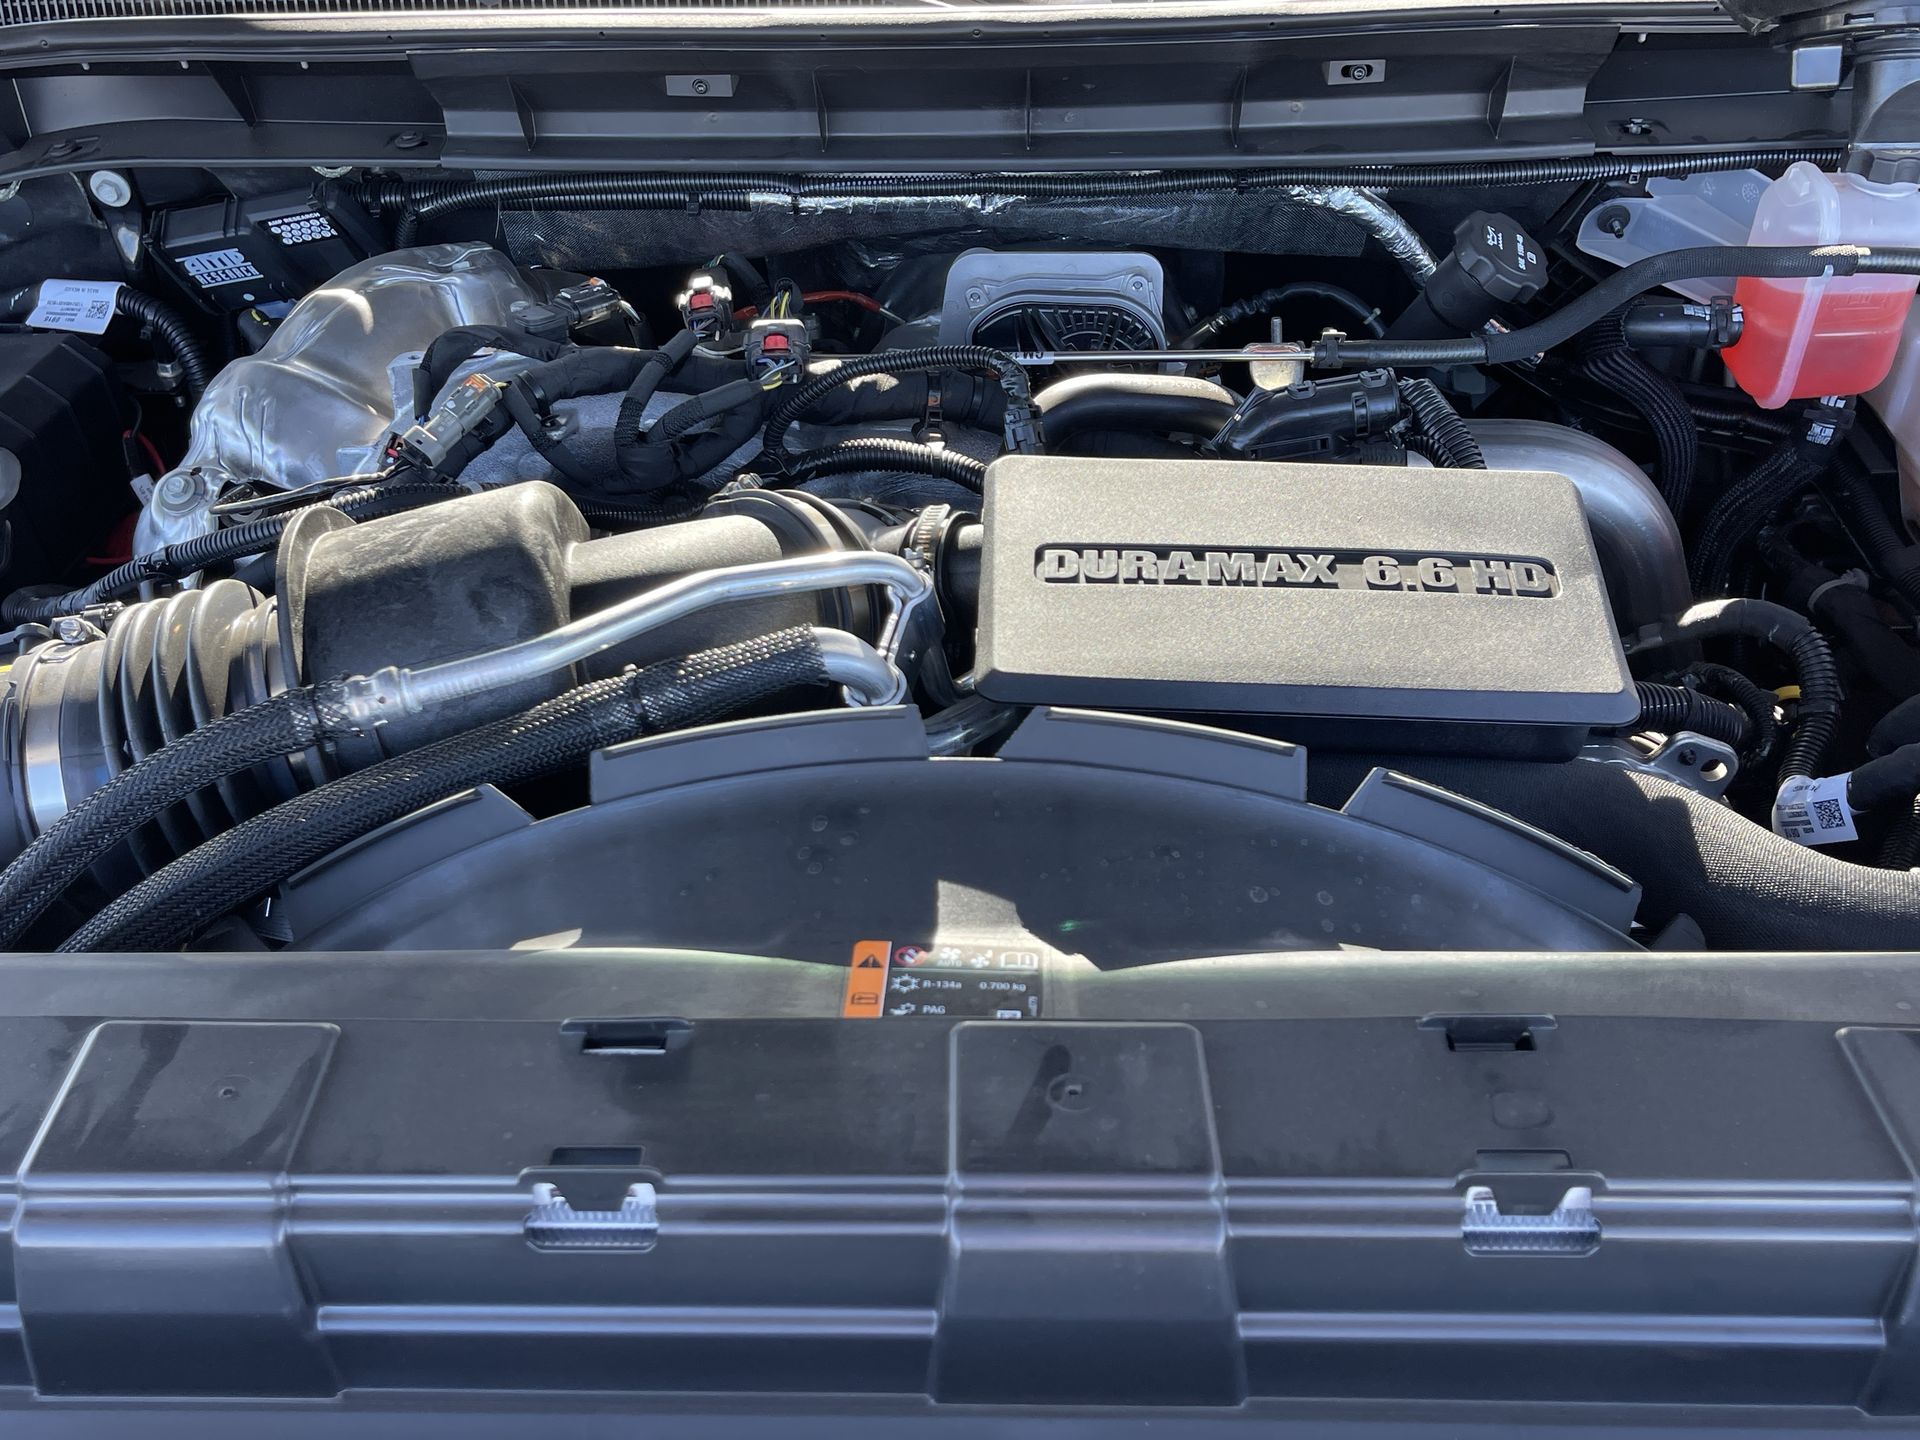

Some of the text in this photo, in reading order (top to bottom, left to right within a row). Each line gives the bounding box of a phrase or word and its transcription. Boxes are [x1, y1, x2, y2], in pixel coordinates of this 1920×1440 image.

[283, 212, 321, 224] RESEARCH
[183, 250, 245, 275] AMP
[195, 265, 260, 285] RESEARCH
[1042, 548, 1556, 595] DURAMAX 6.6 HD
[936, 958, 963, 968] AUTO
[922, 979, 1027, 992] R-134a 0.700 kg
[922, 1005, 946, 1015] PAG
